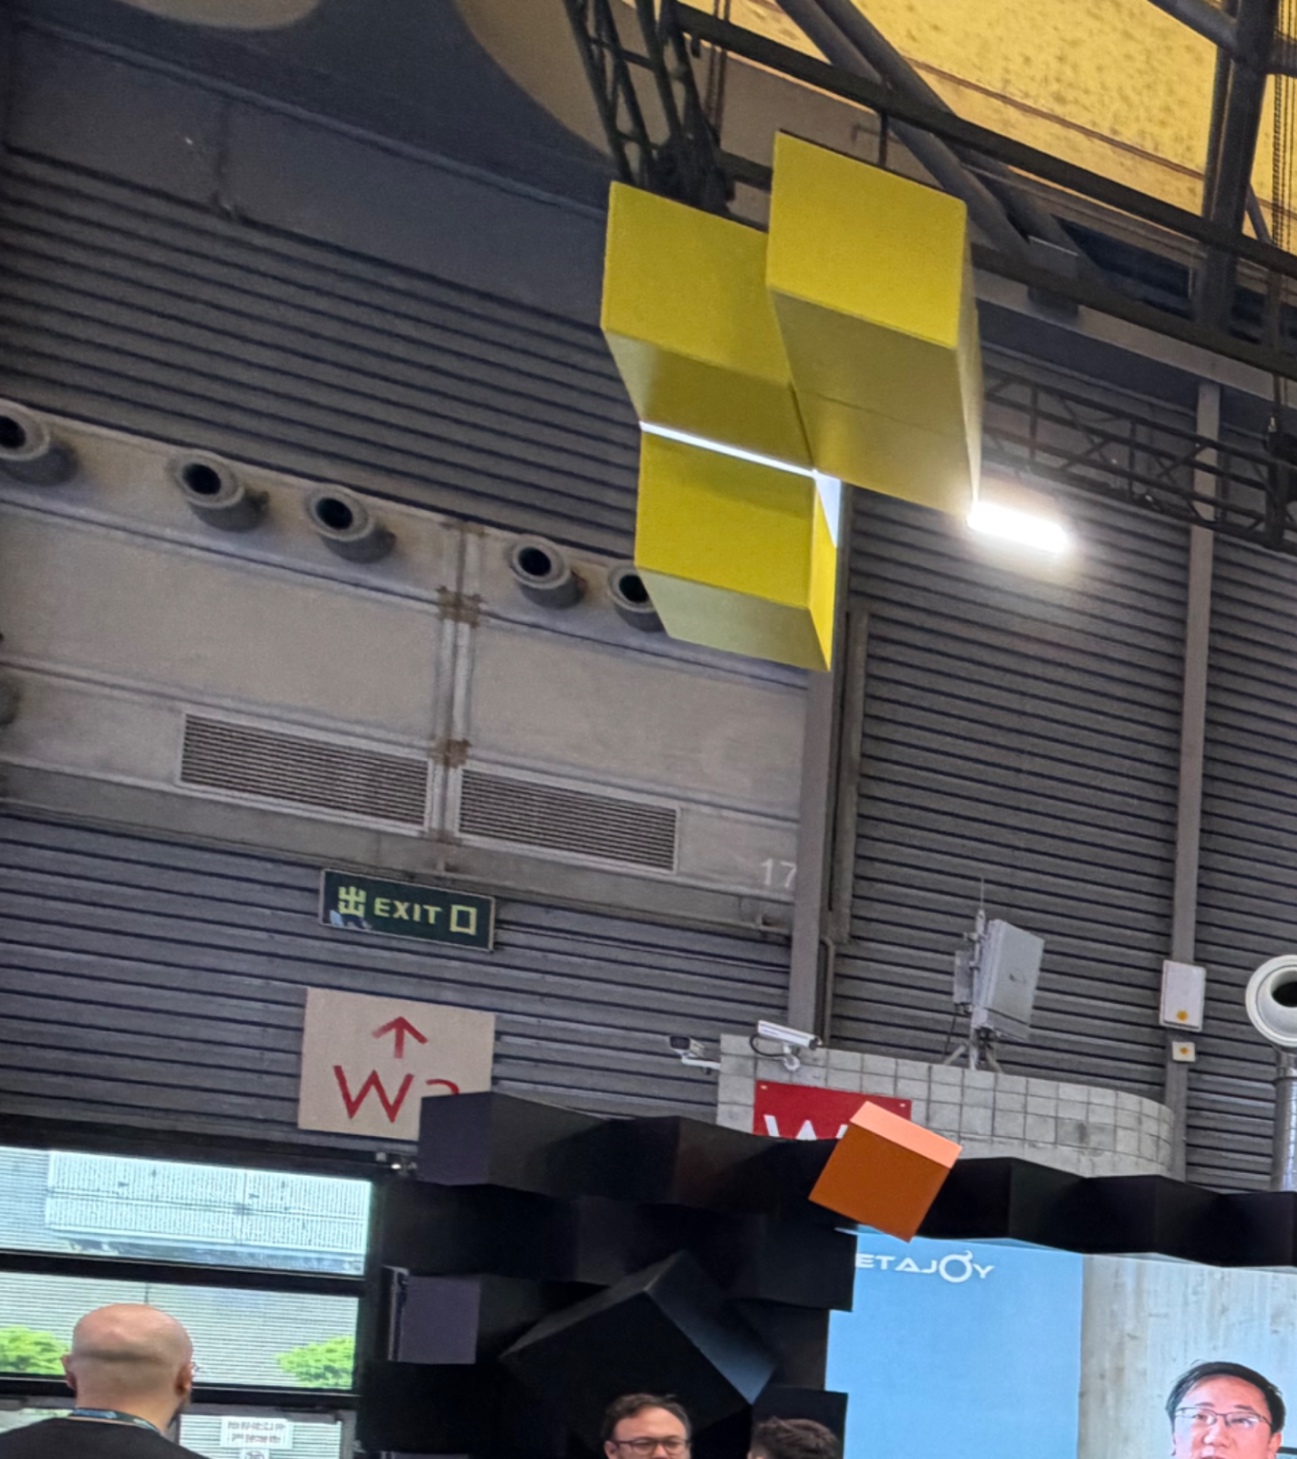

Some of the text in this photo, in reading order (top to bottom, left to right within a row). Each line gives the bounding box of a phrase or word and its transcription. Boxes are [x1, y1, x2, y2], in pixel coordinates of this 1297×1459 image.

[760, 857, 797, 889] 17
[337, 885, 477, 935] 出 EXIT 口
[333, 1065, 460, 1123] W
[855, 1250, 995, 1283] ETAJOY
